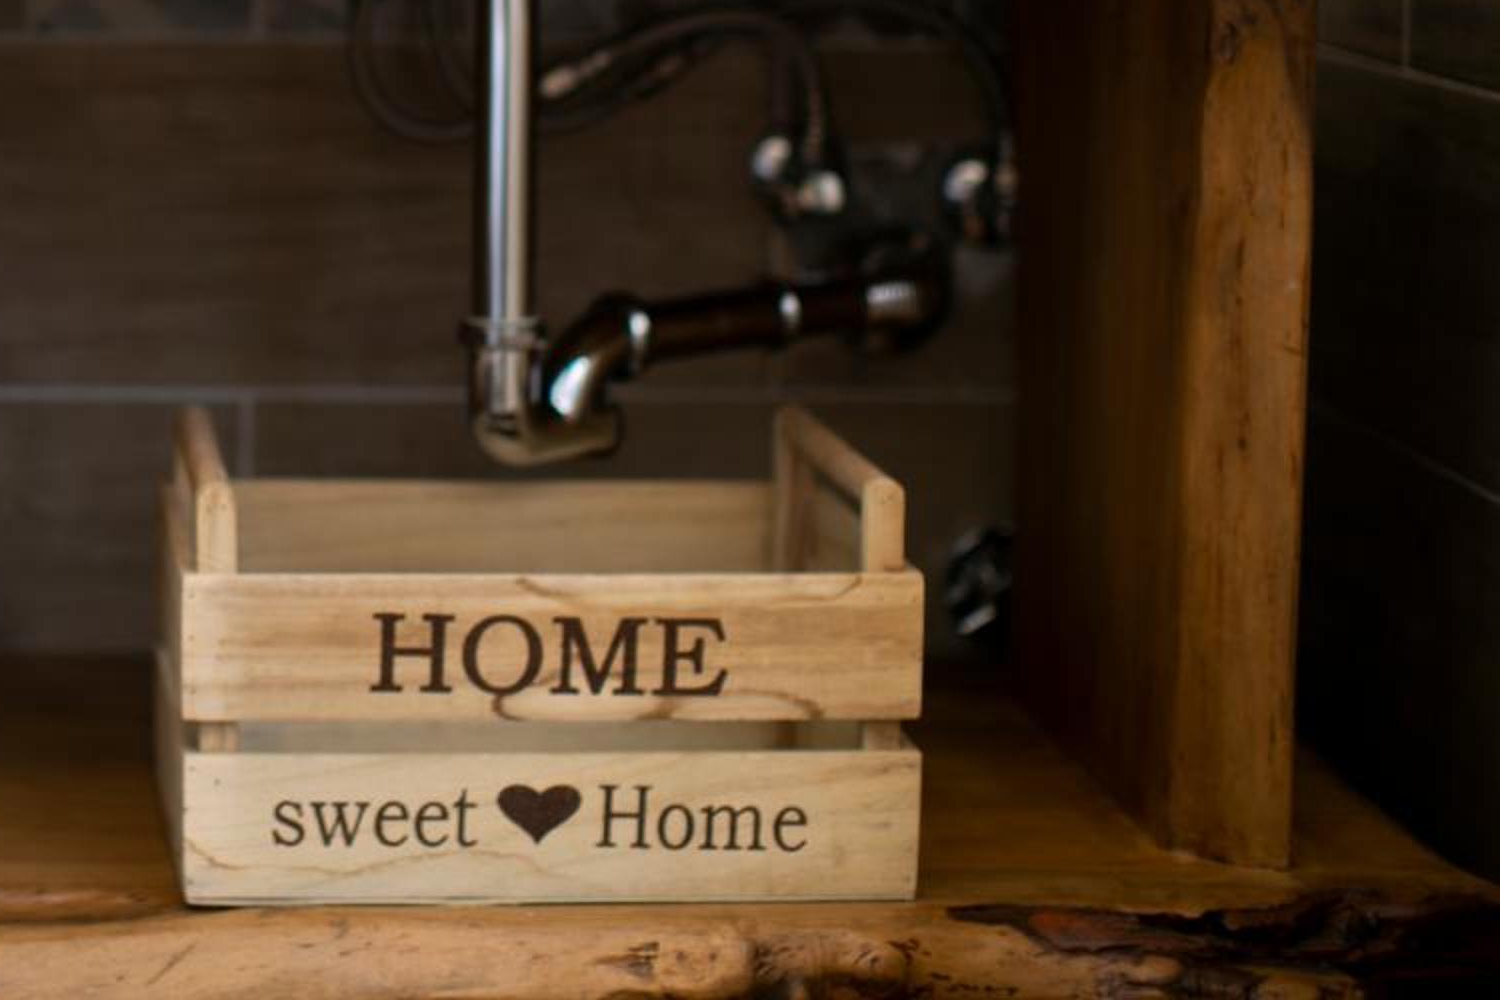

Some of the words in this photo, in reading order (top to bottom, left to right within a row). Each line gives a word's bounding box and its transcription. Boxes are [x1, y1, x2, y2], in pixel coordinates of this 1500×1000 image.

[368, 612, 730, 698] HOME
[271, 787, 477, 848] sweet
[596, 784, 809, 853] Home
